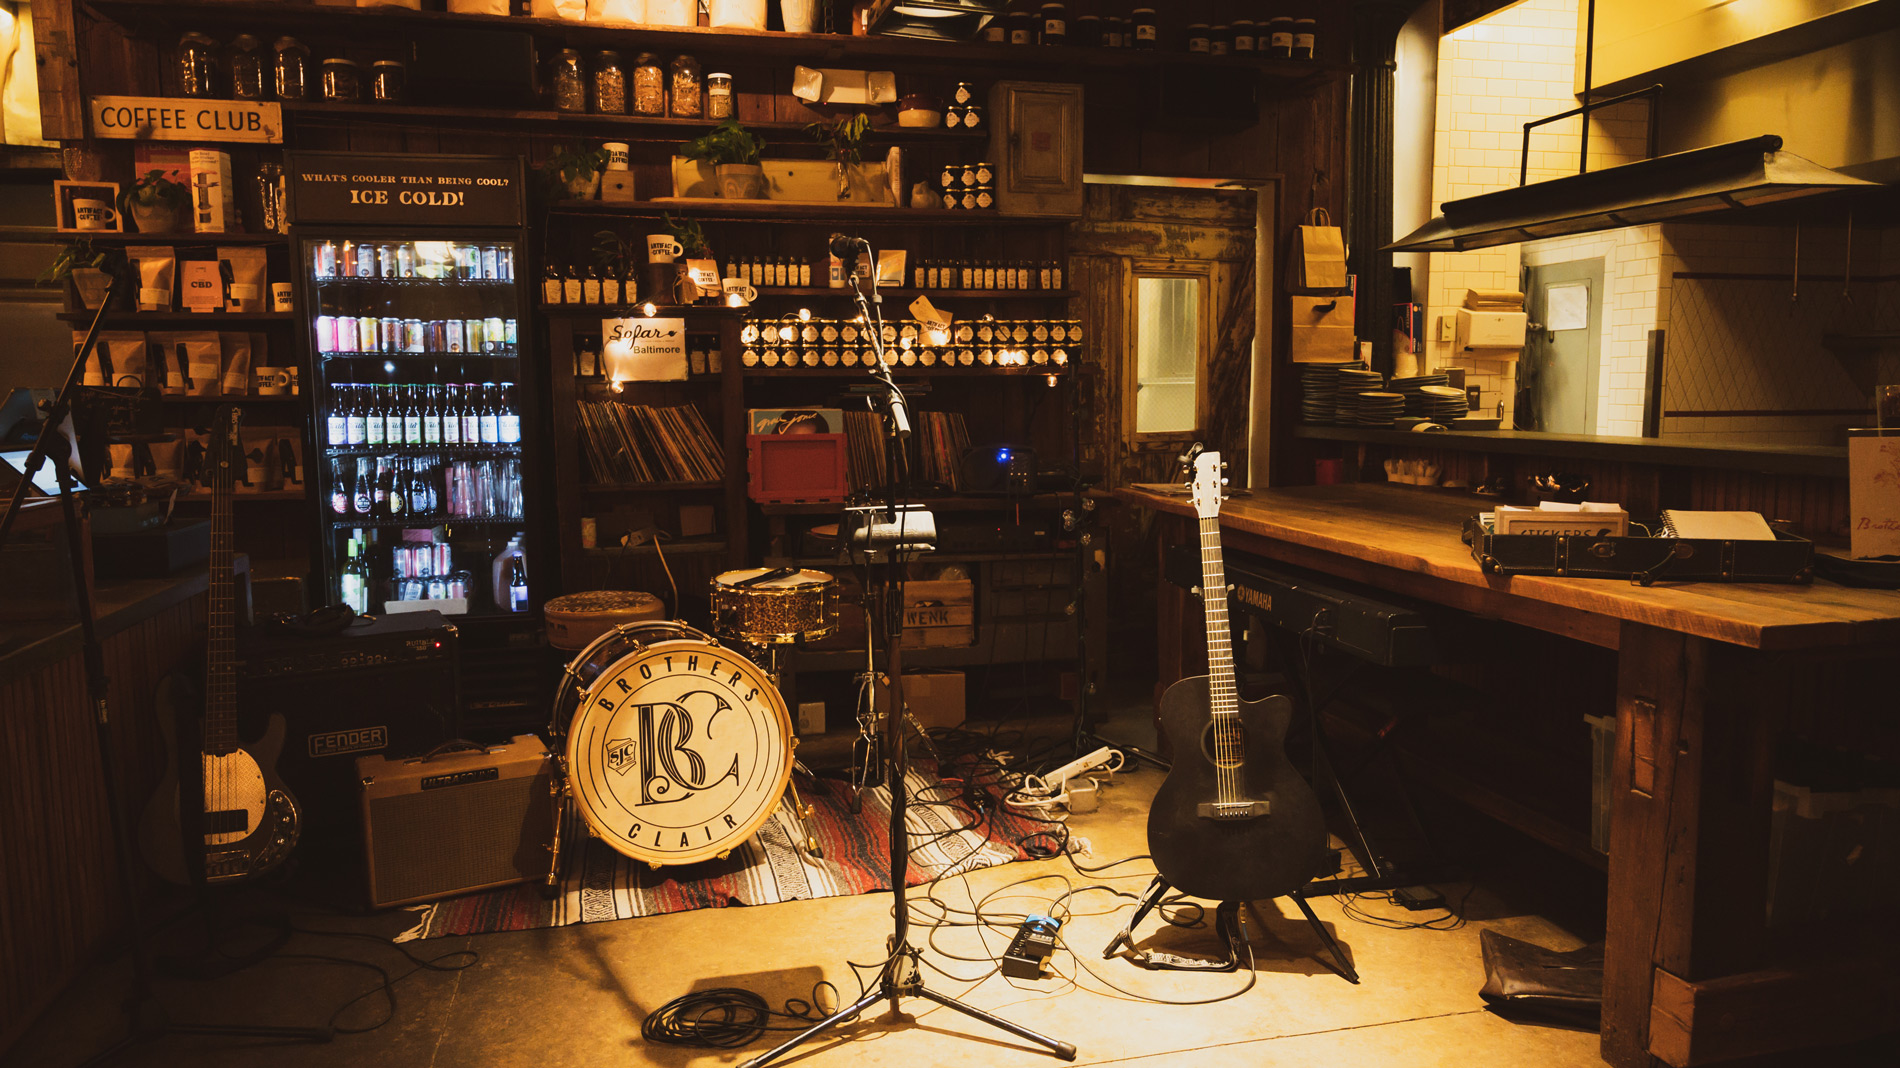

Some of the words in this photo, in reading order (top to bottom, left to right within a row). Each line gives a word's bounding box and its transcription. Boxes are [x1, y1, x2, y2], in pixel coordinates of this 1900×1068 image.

[101, 107, 186, 129] COFFEE
[196, 110, 261, 131] CLUB
[302, 174, 347, 182] WHAT'S
[352, 174, 396, 184] COOLER
[401, 176, 433, 184] THAN
[437, 177, 472, 185] BEING
[476, 177, 509, 187] COOL?
[350, 190, 388, 204] ICE
[399, 191, 465, 206] COLD!
[926, 320, 946, 329] ARTIFACT
[609, 325, 672, 350] Sofar
[633, 345, 680, 353] Baltimore
[1245, 586, 1272, 612] YAMAHA
[906, 611, 949, 624] WENK
[598, 655, 759, 712] BROTHERS
[314, 729, 382, 754] FENDER
[610, 743, 633, 766] SJC
[627, 813, 738, 848] CLAIR
